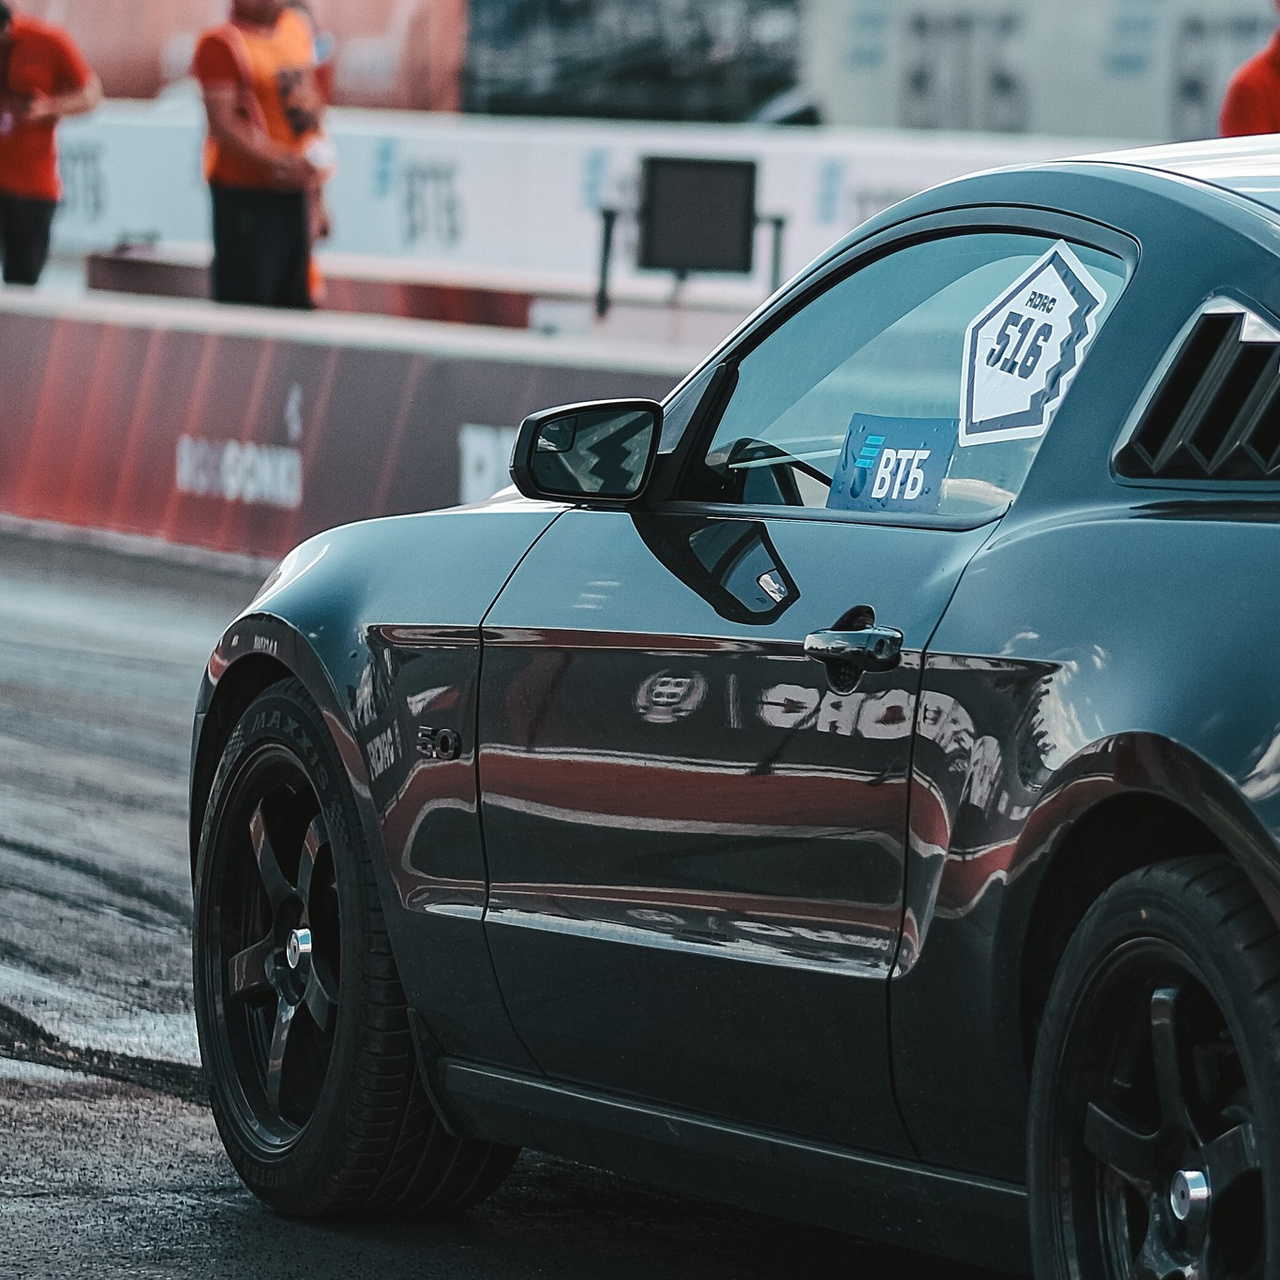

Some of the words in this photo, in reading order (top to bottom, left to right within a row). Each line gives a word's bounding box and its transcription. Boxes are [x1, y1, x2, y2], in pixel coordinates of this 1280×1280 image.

[1025, 290, 1057, 314] RDRC
[986, 310, 1053, 380] 516
[871, 448, 931, 500] ВТБ
[251, 710, 329, 790] MAXXIS
